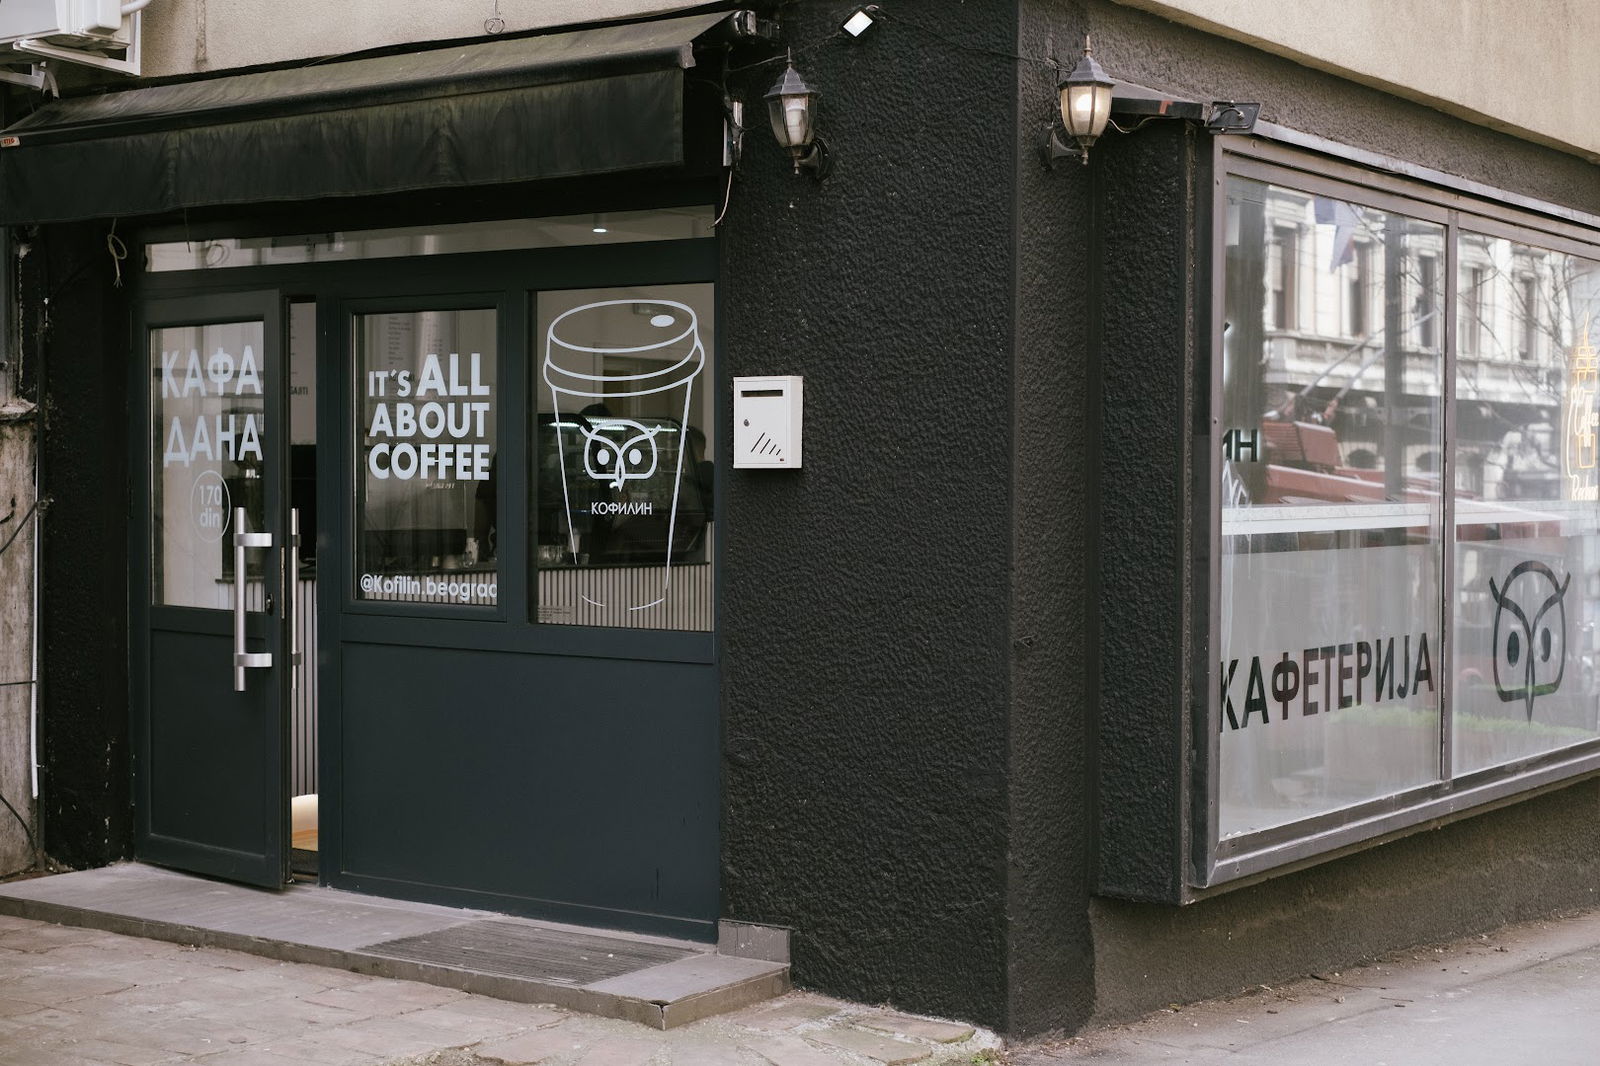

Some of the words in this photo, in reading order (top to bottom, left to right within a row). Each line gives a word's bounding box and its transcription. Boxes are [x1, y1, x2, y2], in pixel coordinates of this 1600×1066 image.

[161, 344, 264, 399] КАФА
[415, 352, 490, 397] ALL
[368, 401, 490, 439] ABOUT
[163, 413, 264, 468] ДАНА
[368, 442, 490, 481] COFFEE
[199, 484, 222, 506] 170
[591, 501, 653, 516] КОФИЛИН
[200, 507, 221, 529] din
[1220, 632, 1434, 734] КАФЕТЕРИЈА
